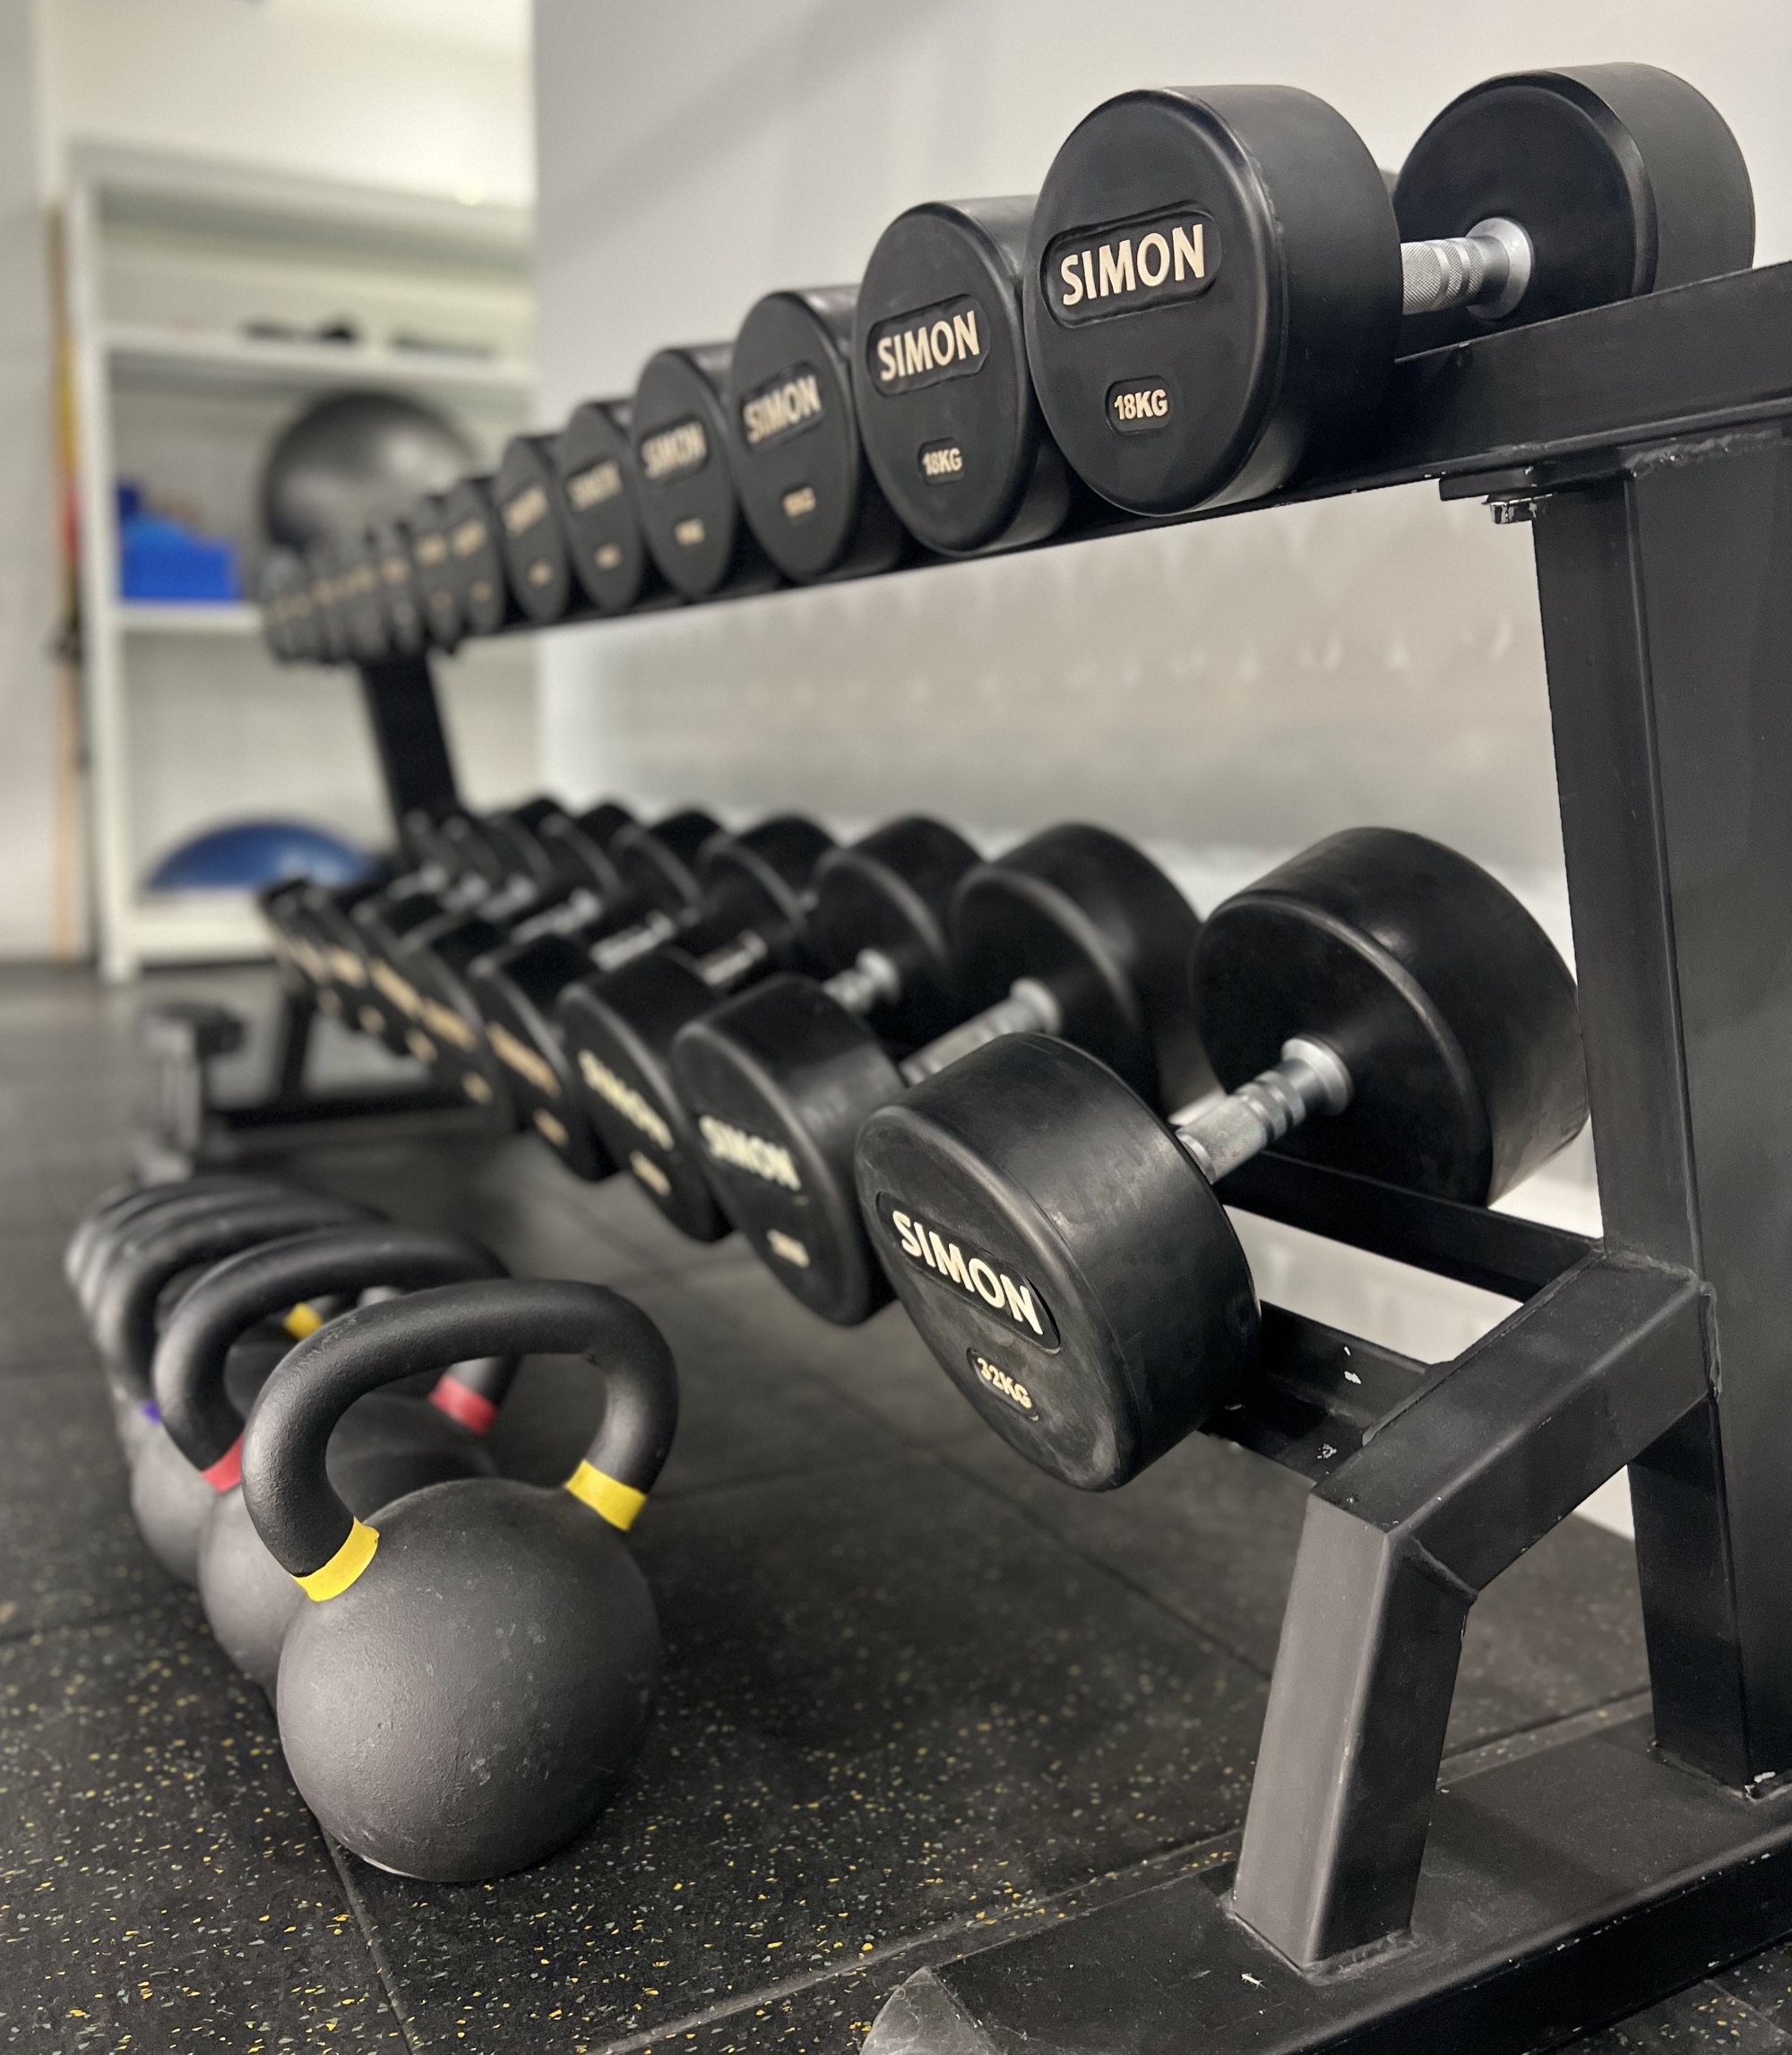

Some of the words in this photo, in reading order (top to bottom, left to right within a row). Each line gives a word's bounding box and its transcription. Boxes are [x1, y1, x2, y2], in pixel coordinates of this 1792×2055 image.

[1060, 223, 1205, 306] SIMON
[877, 310, 980, 382] SIMON
[743, 374, 822, 444] SIMON
[1114, 389, 1168, 420] 18KG
[892, 1210, 1044, 1335] SIMON
[977, 1357, 1032, 1408] 32KG
